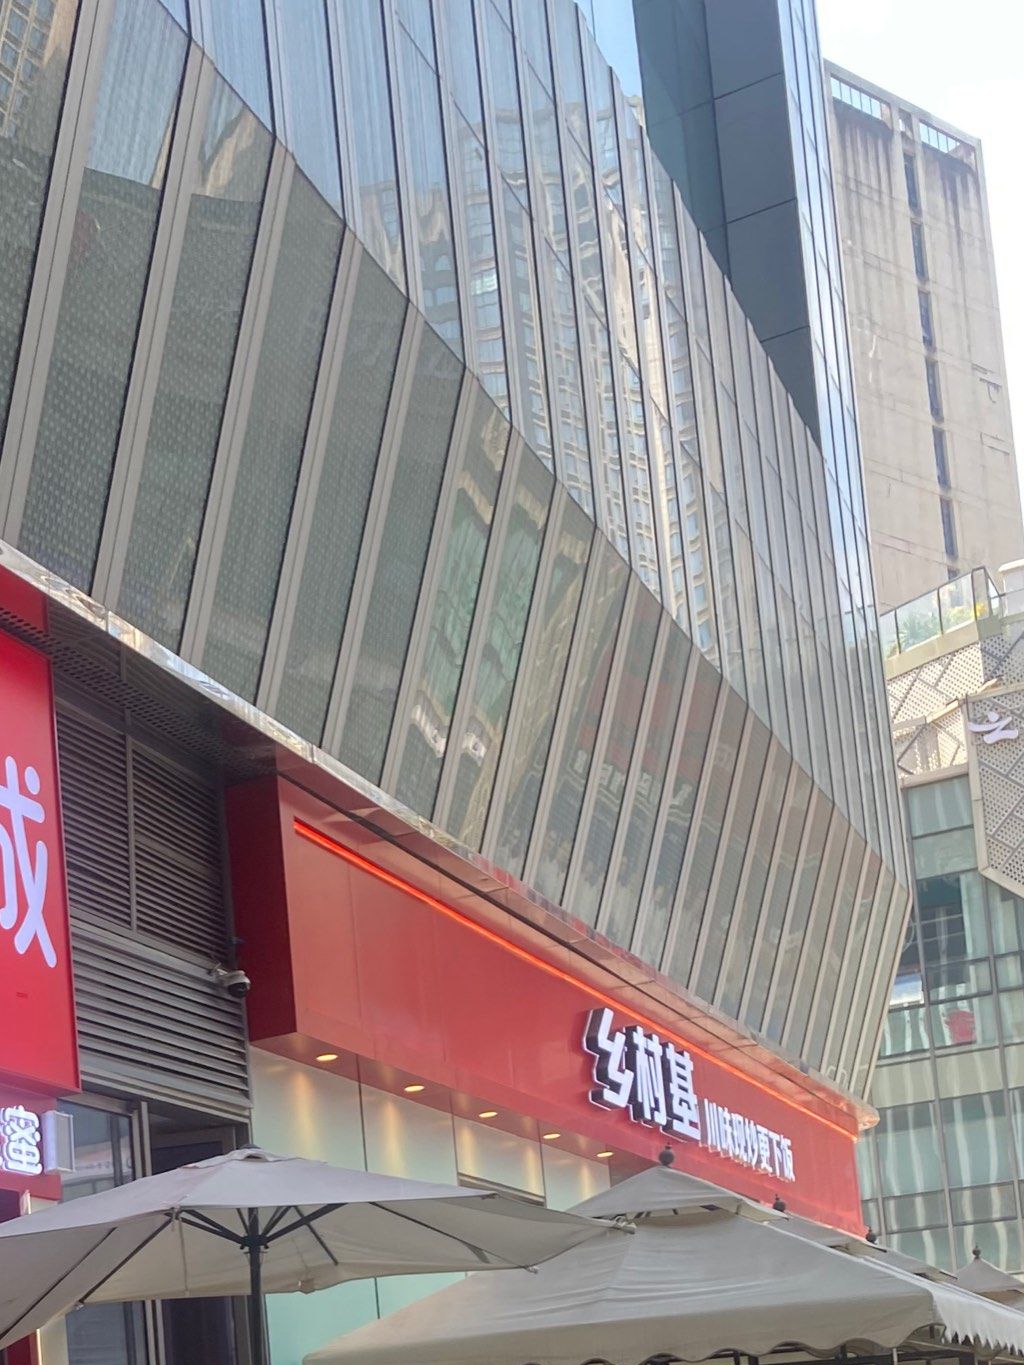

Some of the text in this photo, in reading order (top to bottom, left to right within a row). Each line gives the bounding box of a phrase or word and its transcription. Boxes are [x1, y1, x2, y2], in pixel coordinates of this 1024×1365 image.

[583, 1007, 795, 1182] 乡村基 川味现炒更下饭
